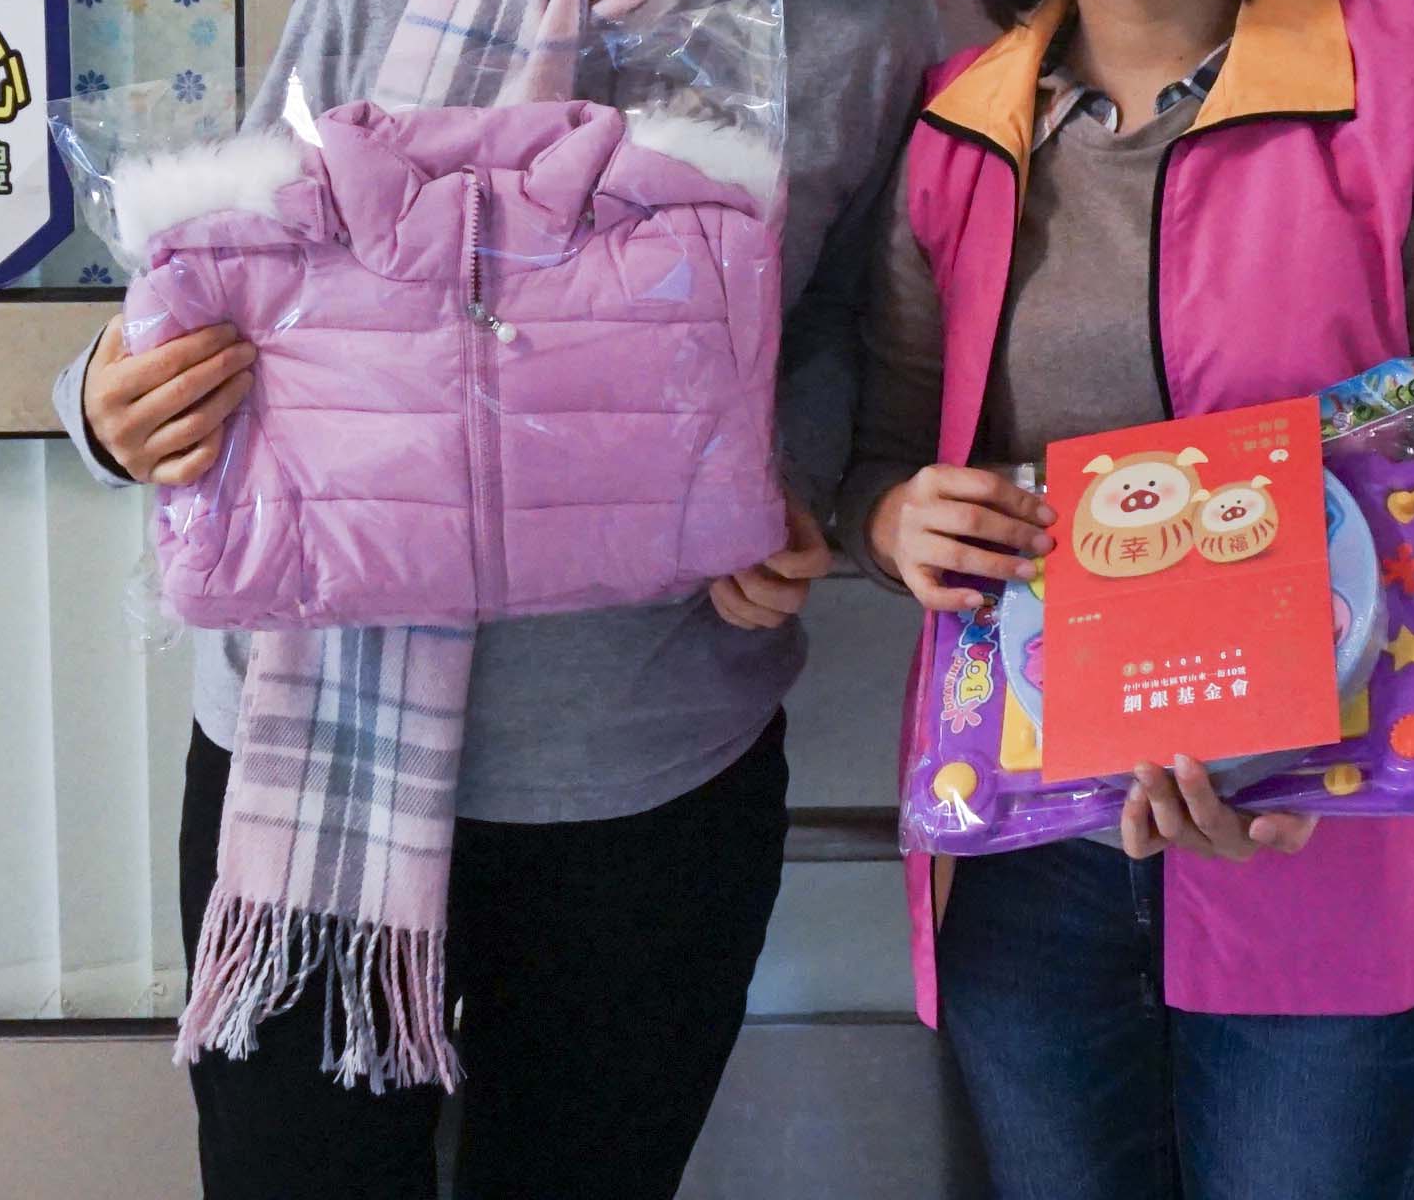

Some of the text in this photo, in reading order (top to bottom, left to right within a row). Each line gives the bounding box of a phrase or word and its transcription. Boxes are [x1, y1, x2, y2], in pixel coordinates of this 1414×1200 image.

[1119, 536, 1150, 563] 幸
[1228, 534, 1249, 553] 福
[1123, 678, 1249, 713] 網銀基金會
